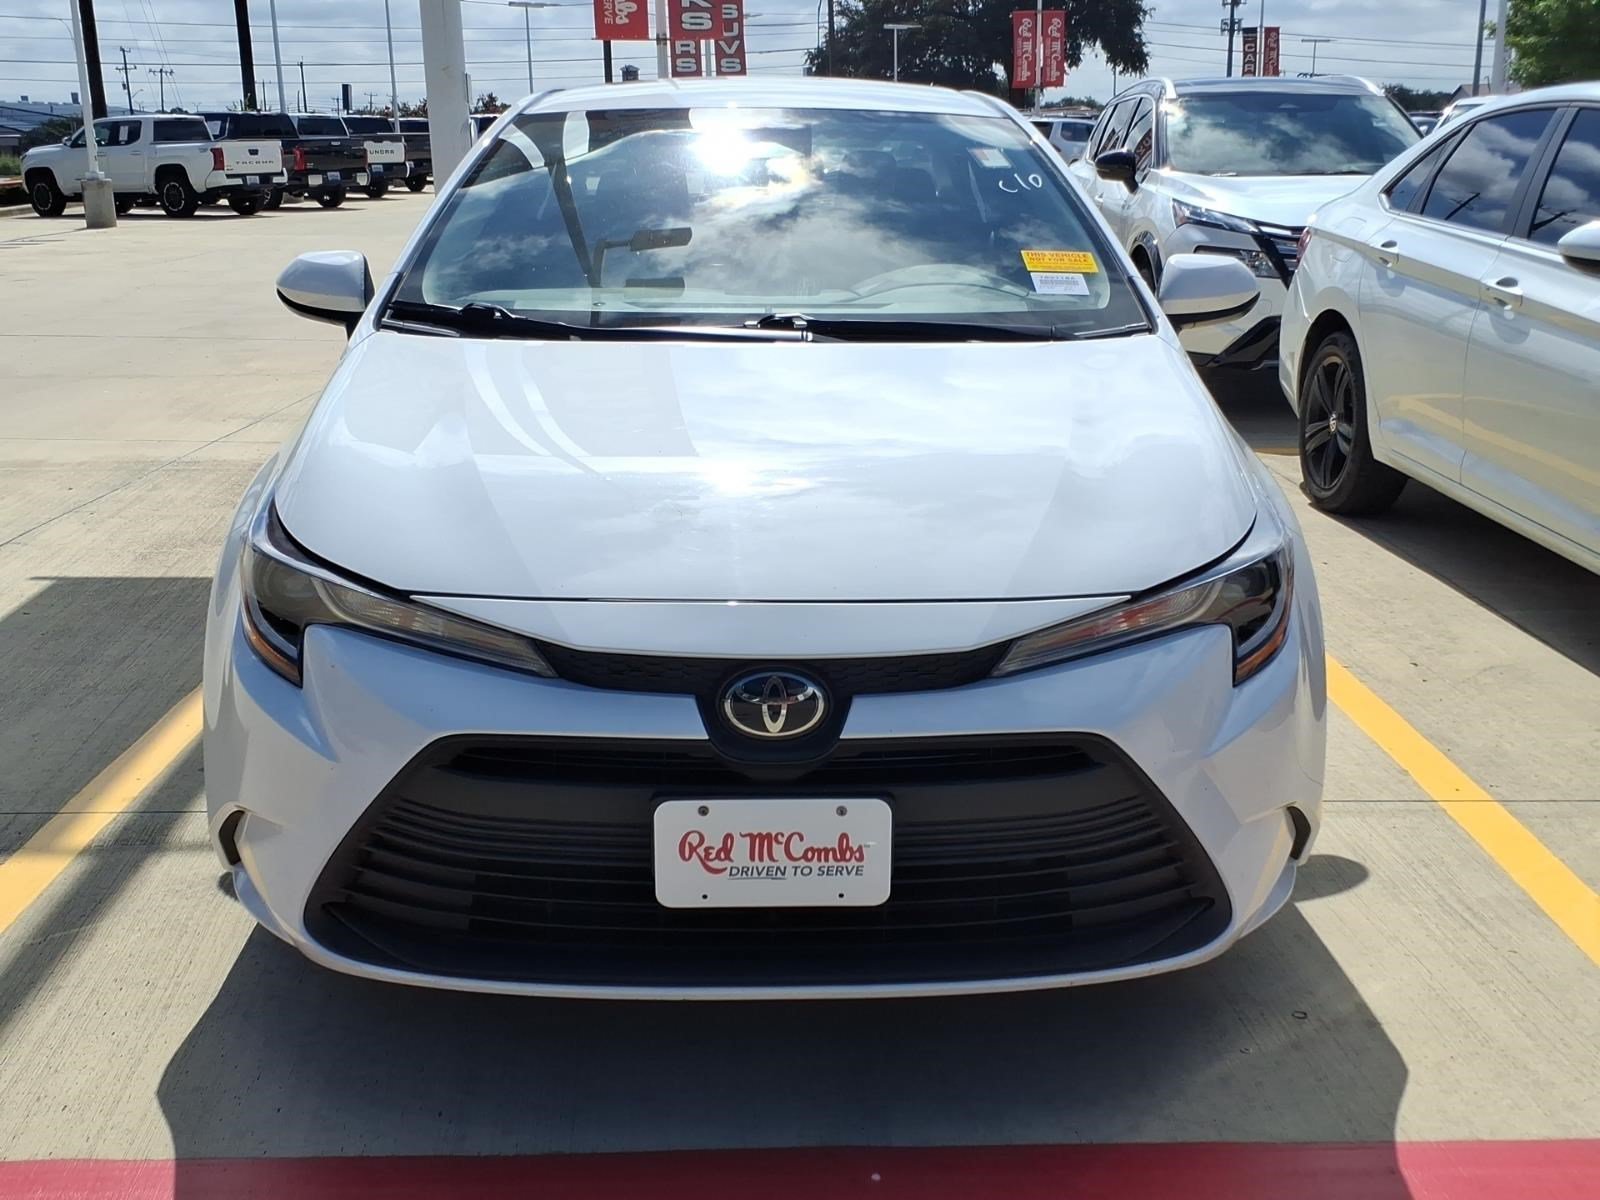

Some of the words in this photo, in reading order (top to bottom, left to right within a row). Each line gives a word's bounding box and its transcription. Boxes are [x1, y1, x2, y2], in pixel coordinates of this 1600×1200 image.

[604, 0, 616, 25] RVE
[615, 0, 638, 25] bs
[719, 4, 741, 73] SUVS
[678, 830, 734, 875] Red
[739, 831, 865, 863] McCombs
[728, 865, 787, 878] DRIVEN
[792, 865, 813, 877] TO
[817, 865, 864, 877] SERVE
